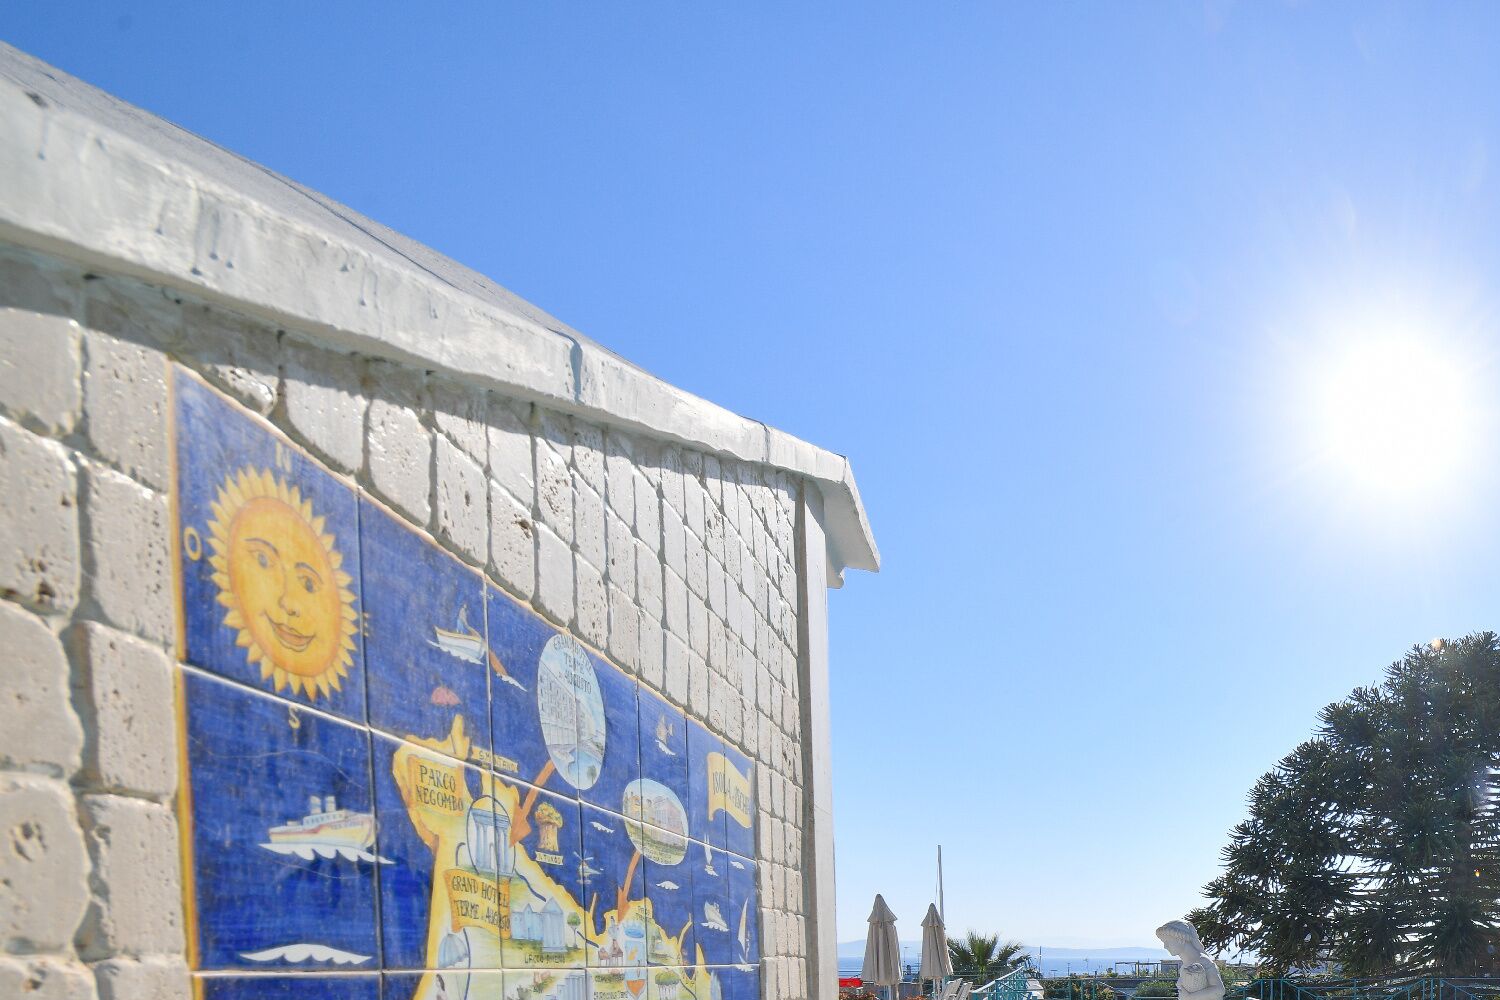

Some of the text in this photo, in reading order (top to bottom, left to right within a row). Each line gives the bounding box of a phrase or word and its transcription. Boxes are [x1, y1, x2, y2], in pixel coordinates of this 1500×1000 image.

[275, 440, 293, 475] N
[184, 527, 201, 562] O
[289, 705, 301, 730] S
[419, 764, 456, 794] PARCO
[415, 784, 464, 814] NEGOMBO
[452, 875, 510, 908] GRAND HOTEL
[453, 899, 480, 920] TERME
